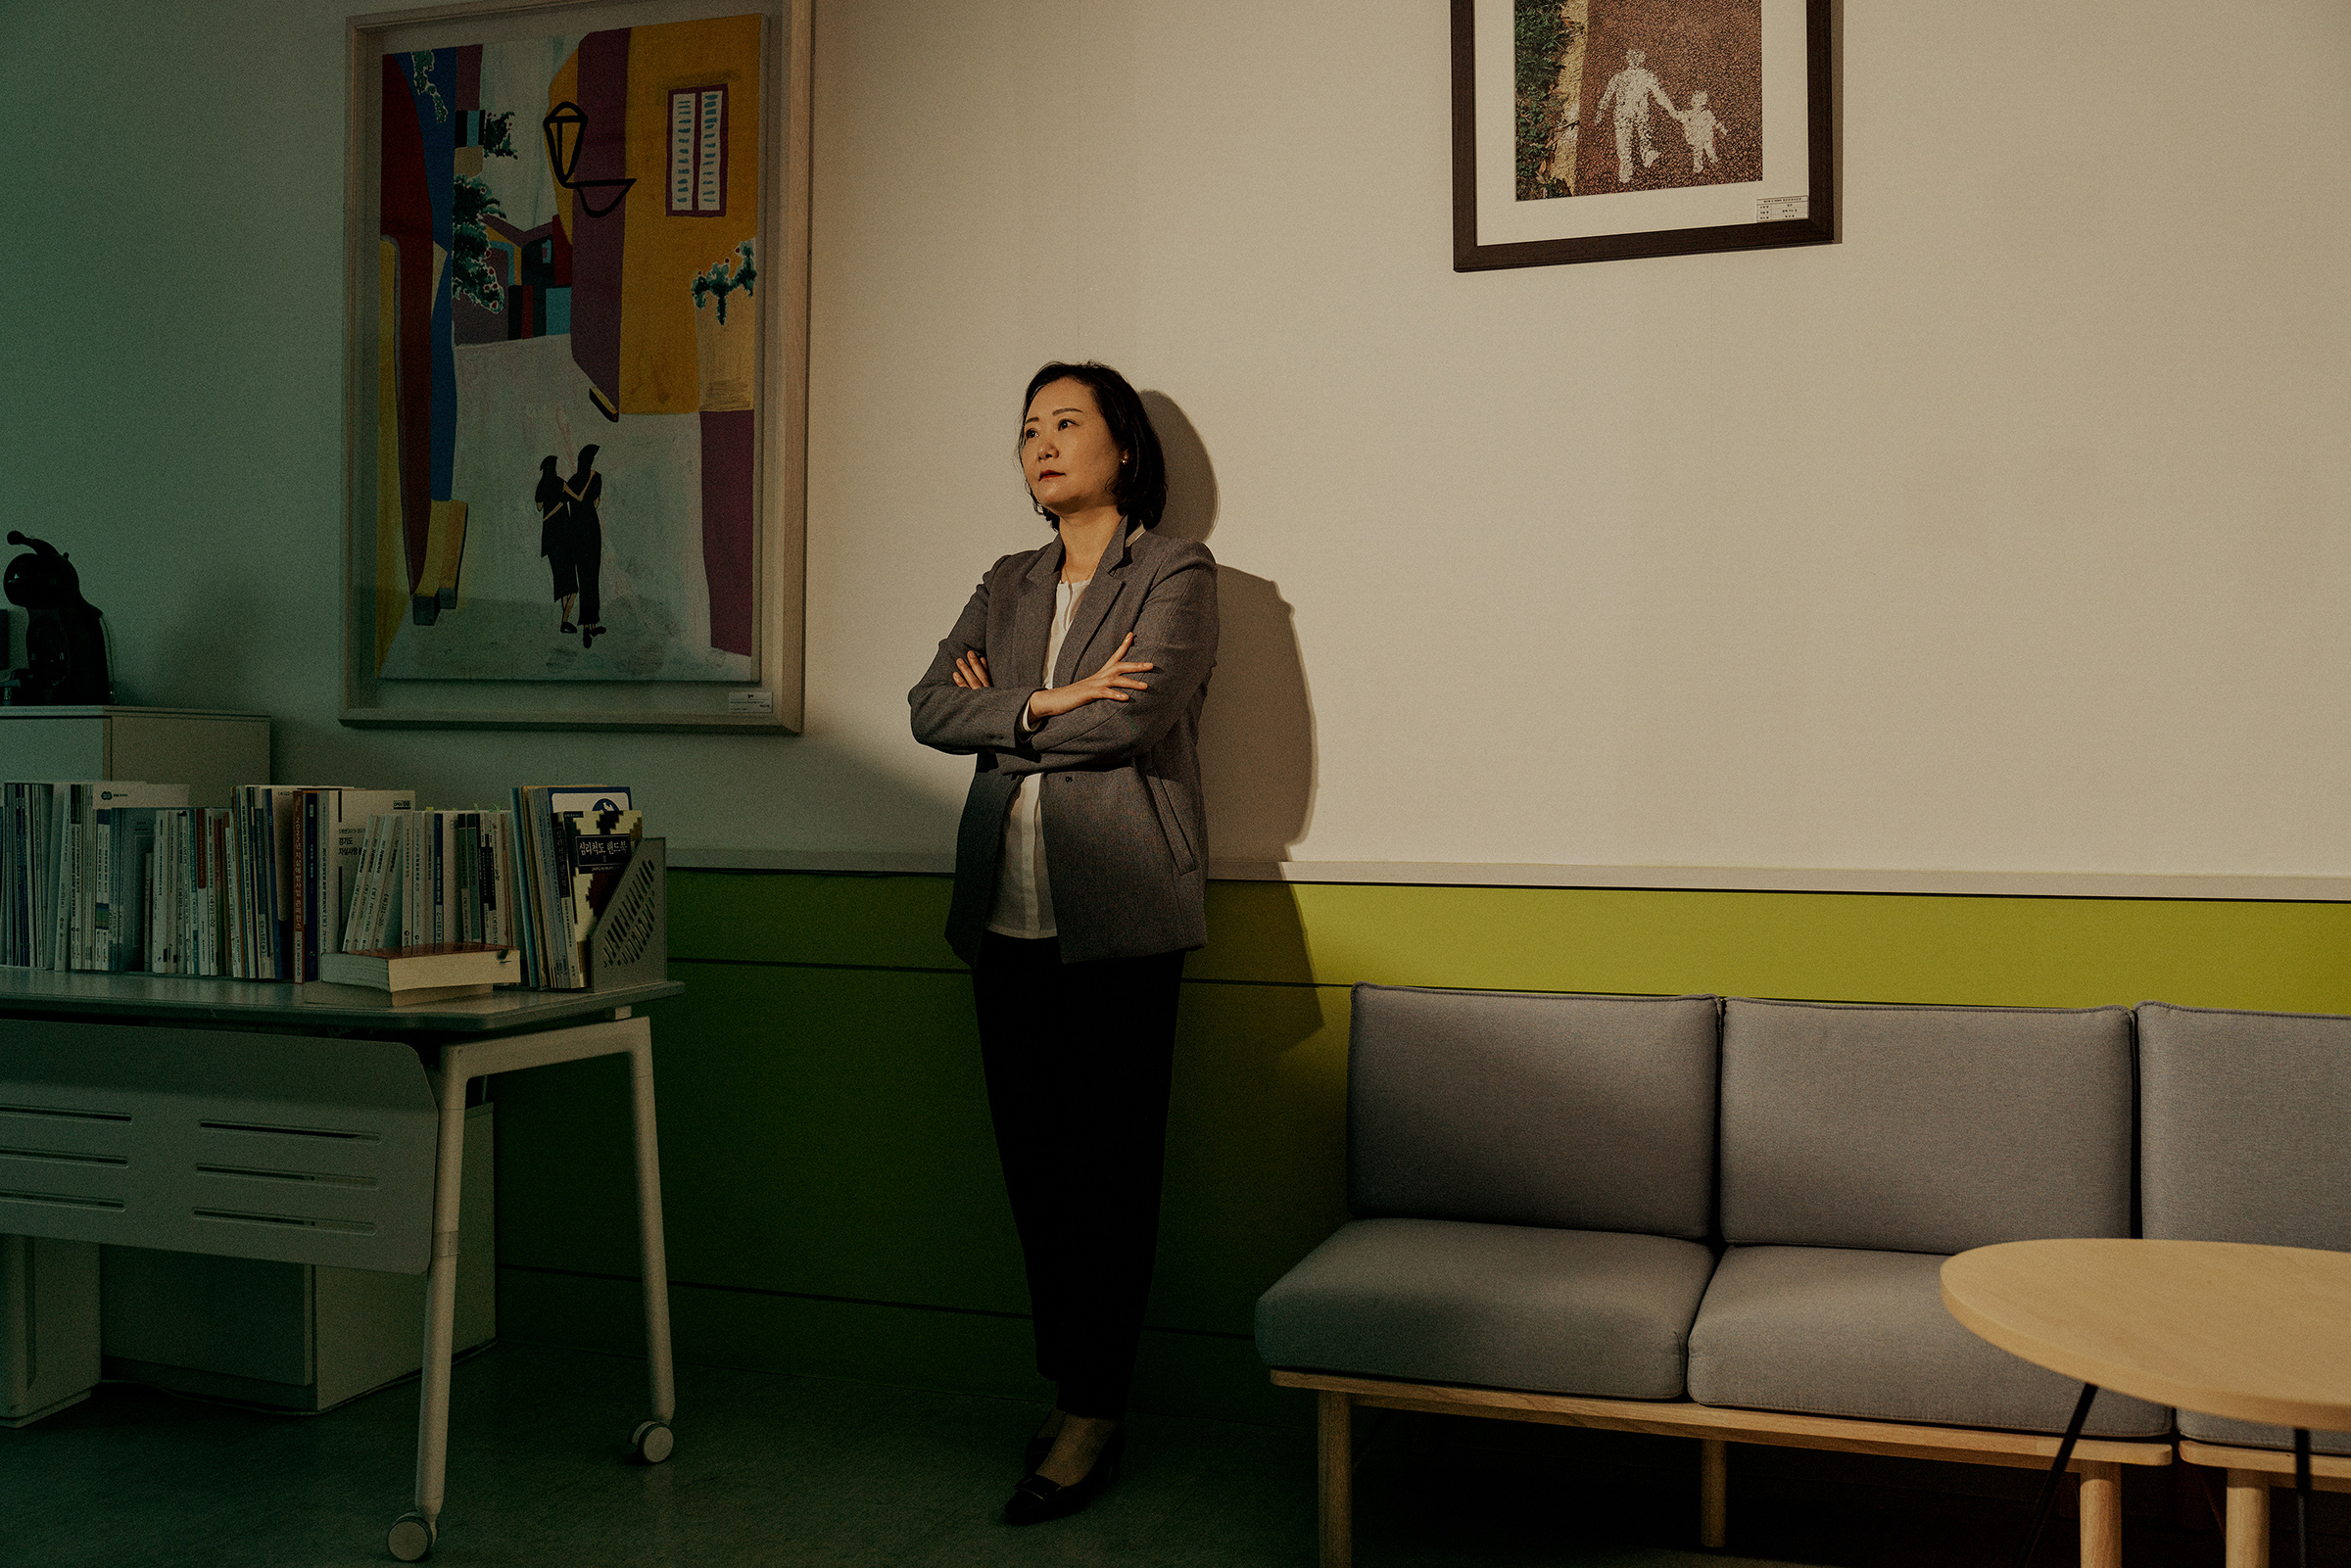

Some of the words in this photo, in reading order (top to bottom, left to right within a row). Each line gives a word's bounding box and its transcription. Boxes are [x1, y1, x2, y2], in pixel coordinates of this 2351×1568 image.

[338, 836, 354, 846] 경기도
[578, 839, 606, 856] 심리척도
[606, 839, 628, 855] 핸드북
